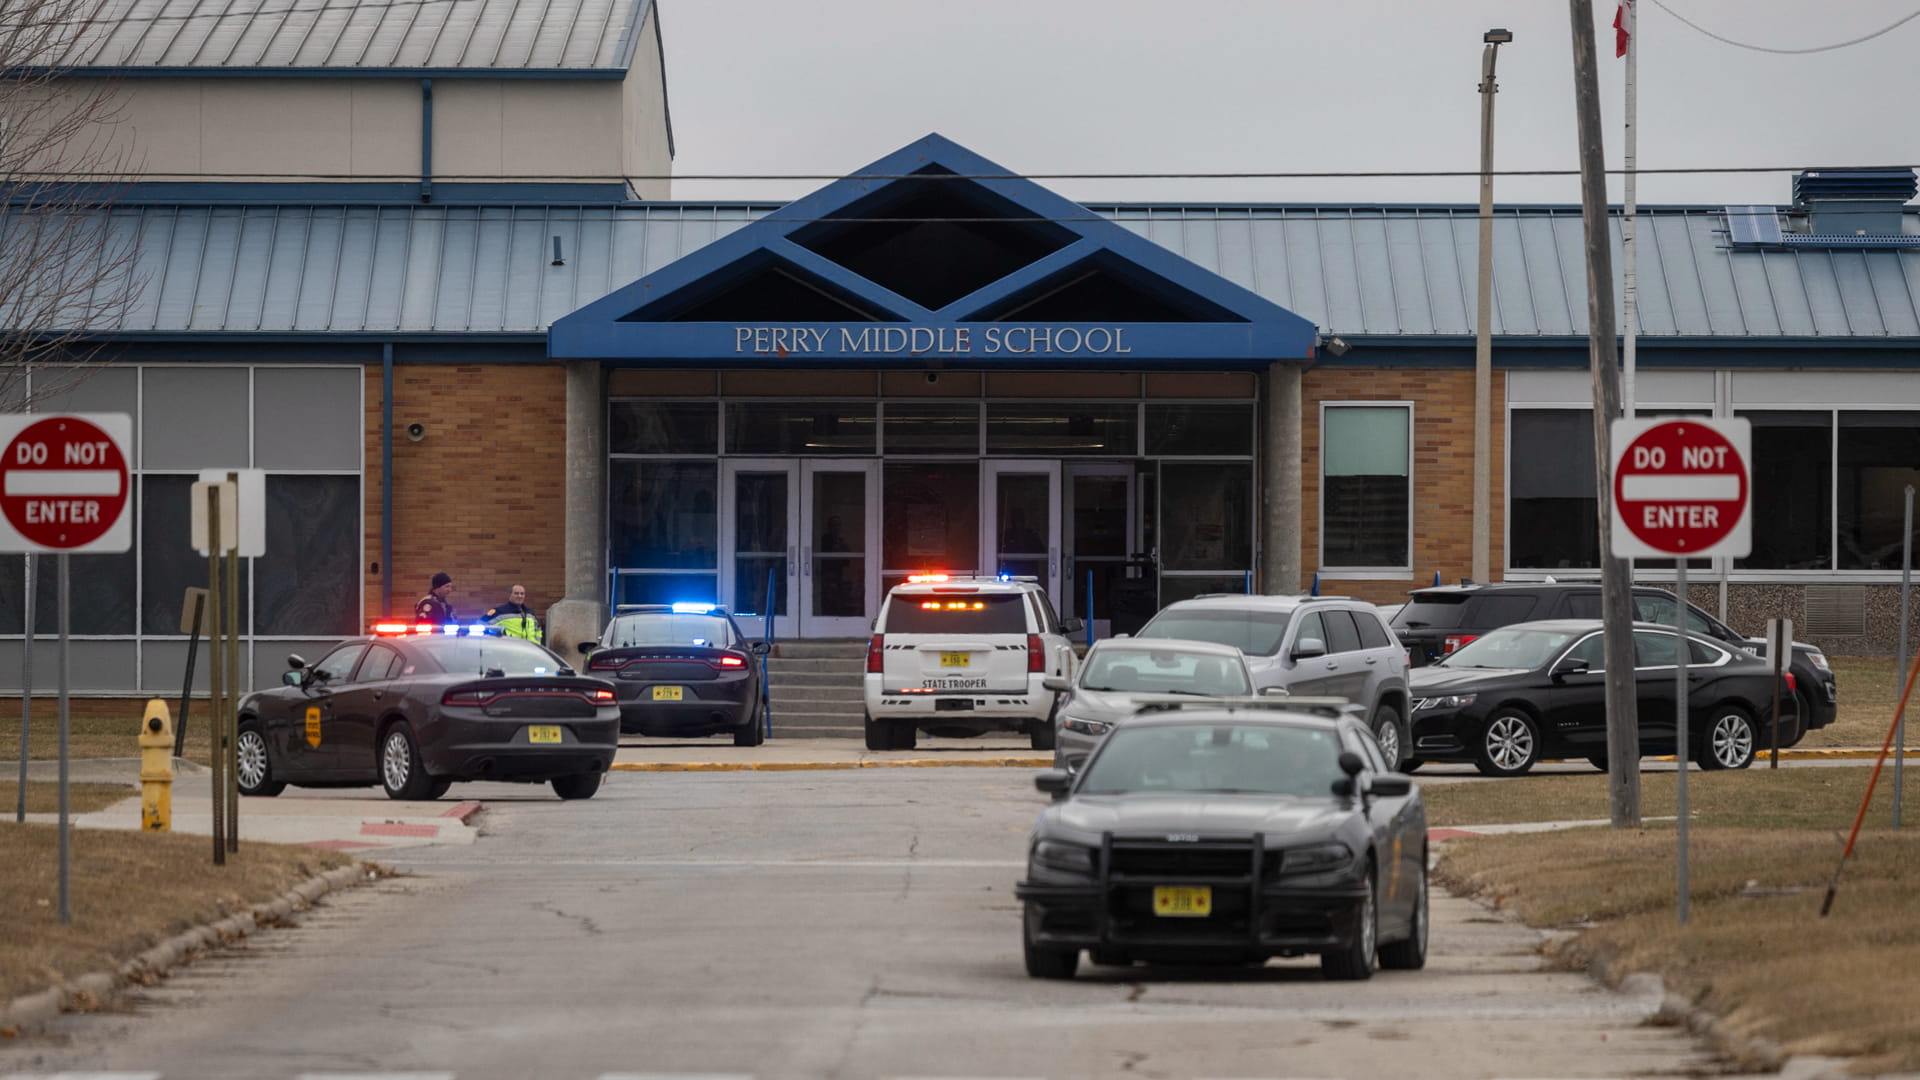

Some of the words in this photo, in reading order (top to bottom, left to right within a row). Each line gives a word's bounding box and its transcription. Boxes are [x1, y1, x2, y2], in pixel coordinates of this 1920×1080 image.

[735, 327, 831, 353] PERRY
[839, 327, 971, 353] MIDDLE
[984, 327, 1132, 353] SCHOOL
[16, 441, 48, 465] DO
[63, 441, 110, 465] NOT
[1633, 446, 1666, 470] DO
[1682, 446, 1728, 470] NOT
[25, 500, 100, 524] ENTER
[1643, 505, 1719, 529] ENTER
[922, 679, 948, 689] STATE
[948, 679, 987, 689] TROOPER
